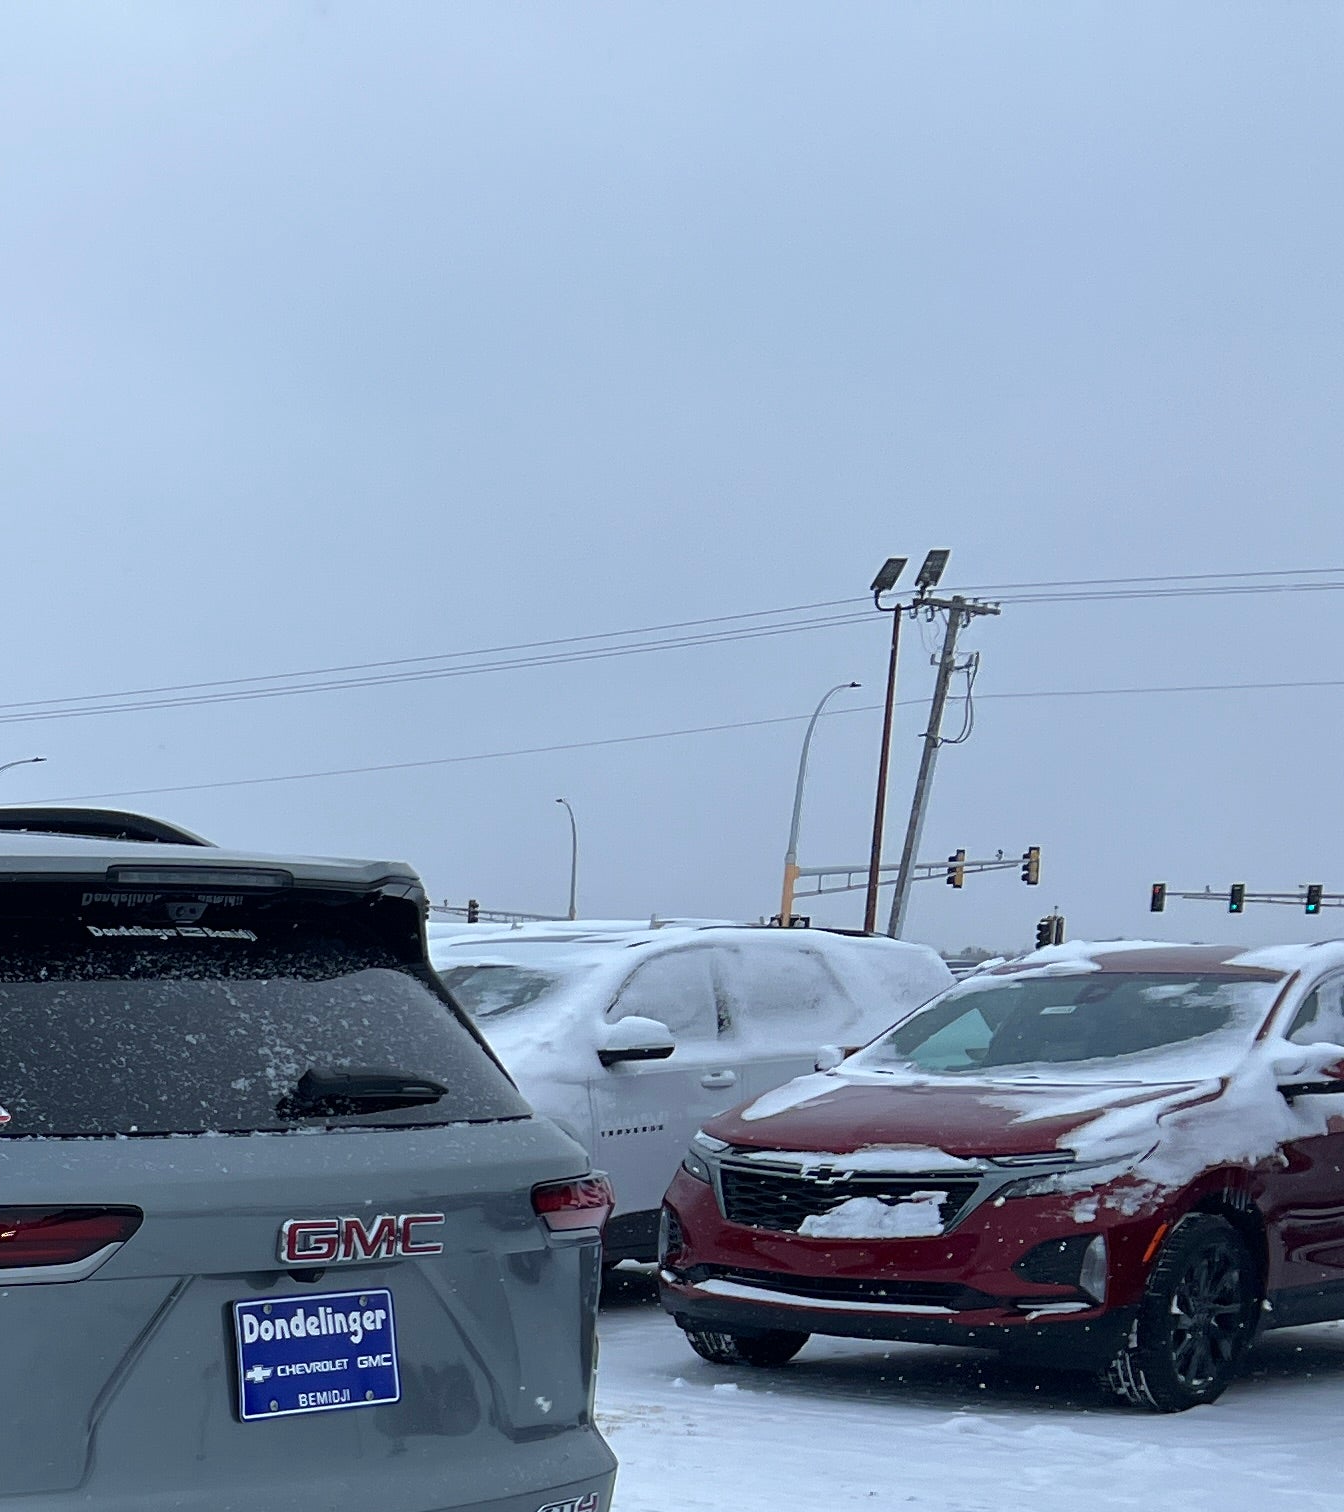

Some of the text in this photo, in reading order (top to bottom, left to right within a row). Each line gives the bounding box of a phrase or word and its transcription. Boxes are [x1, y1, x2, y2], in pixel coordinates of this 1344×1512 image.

[281, 1214, 444, 1263] GMC
[242, 1307, 386, 1344] Dondelinger
[277, 1353, 392, 1378] CHEVROLET GMC
[298, 1389, 351, 1408] BEMIDJI
